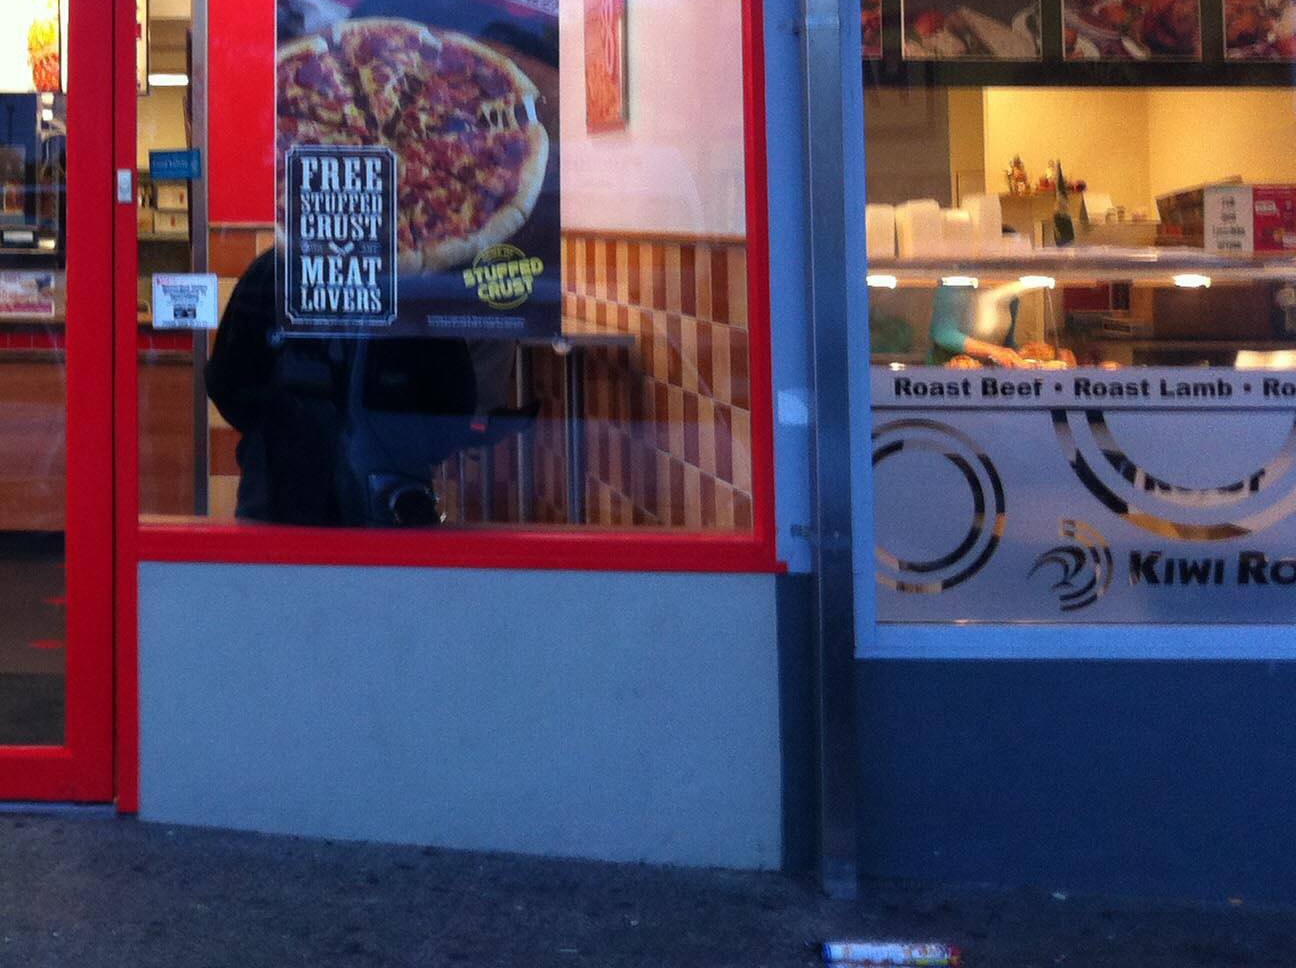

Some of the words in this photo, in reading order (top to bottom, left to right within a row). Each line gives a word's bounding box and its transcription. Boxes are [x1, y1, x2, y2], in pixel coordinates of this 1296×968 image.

[300, 157, 383, 192] FREE
[300, 192, 383, 214] STUFFED
[300, 214, 383, 241] CRUST
[300, 256, 382, 286] MEAT
[463, 257, 544, 288] STUFFED
[301, 287, 382, 312] LOVERS
[478, 275, 534, 302] CRUST
[894, 377, 971, 398] Roast
[981, 377, 1043, 398] Beef
[1074, 377, 1149, 398] Roast
[1160, 378, 1234, 398] Lamb
